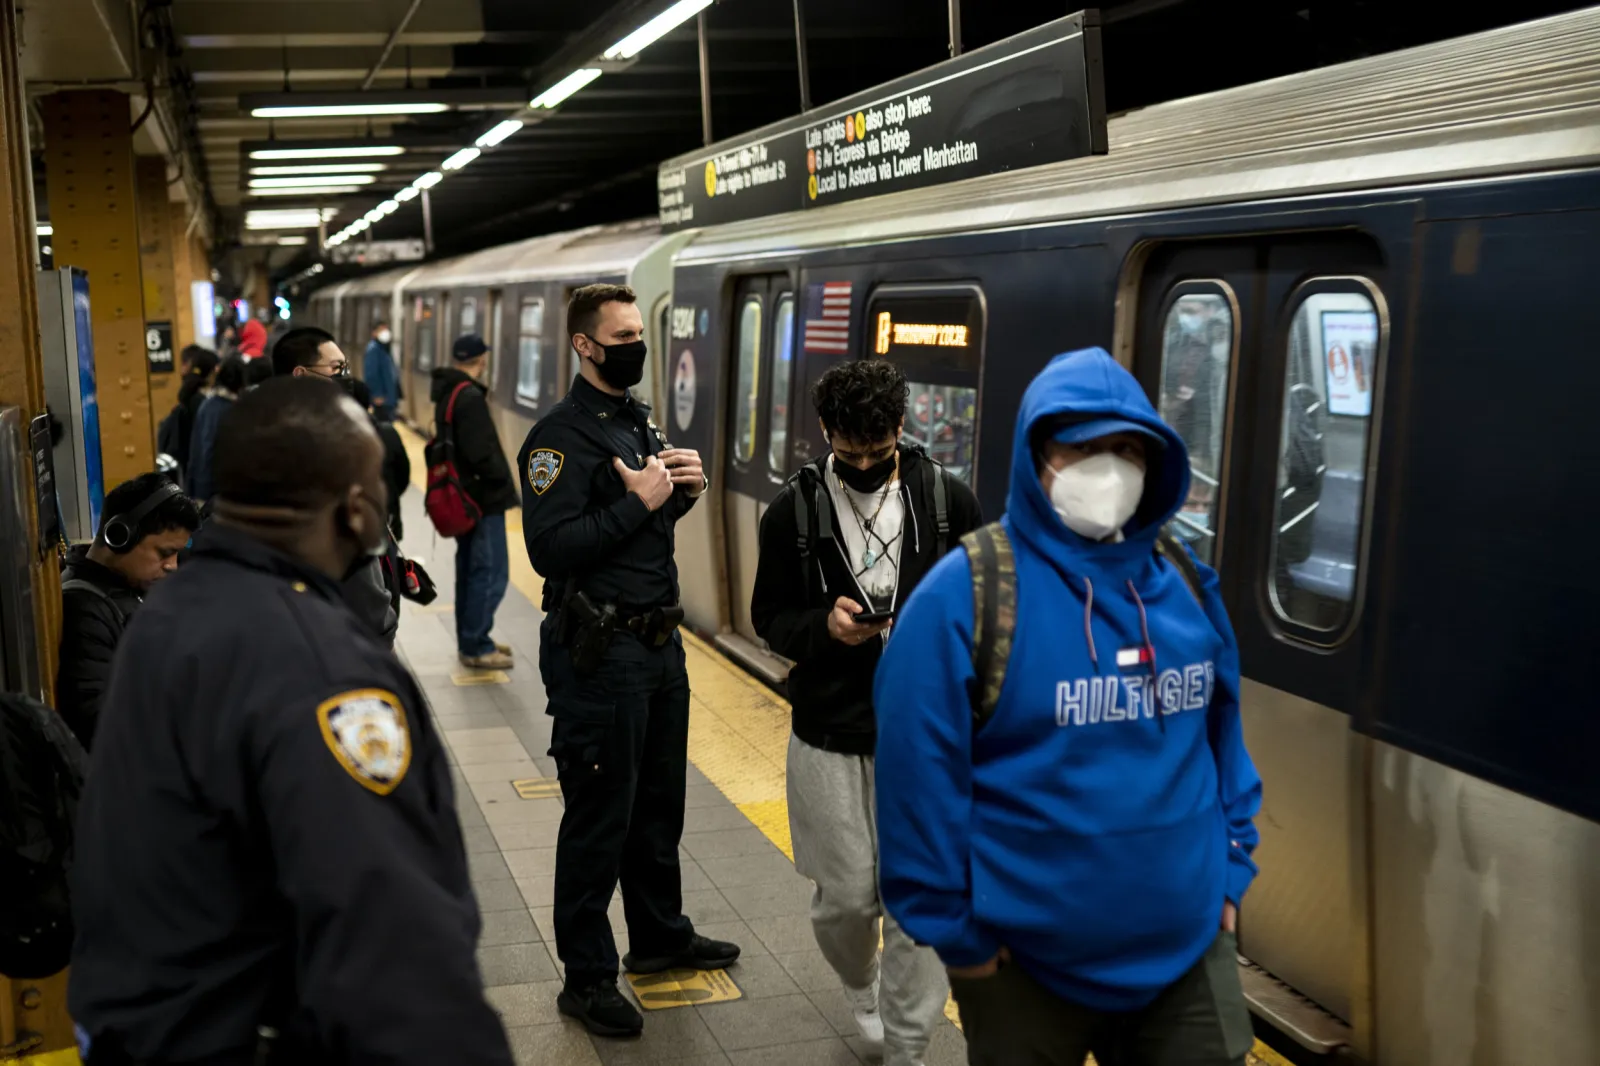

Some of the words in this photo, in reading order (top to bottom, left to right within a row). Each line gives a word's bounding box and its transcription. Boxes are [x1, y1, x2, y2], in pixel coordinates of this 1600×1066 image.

[805, 128, 822, 149] Late
[823, 120, 846, 146] nights
[866, 108, 883, 131] also
[885, 102, 905, 126] stop
[906, 94, 932, 119] here:
[816, 149, 822, 170] 6
[823, 148, 833, 168] Av
[834, 142, 865, 168] Express
[866, 134, 880, 156] via
[881, 127, 910, 154] Bridge
[816, 170, 837, 194] Local
[838, 170, 847, 189] to
[848, 161, 877, 187] Astoria
[878, 157, 892, 180] via
[893, 154, 921, 178] Lower
[923, 140, 978, 171] Manhattan
